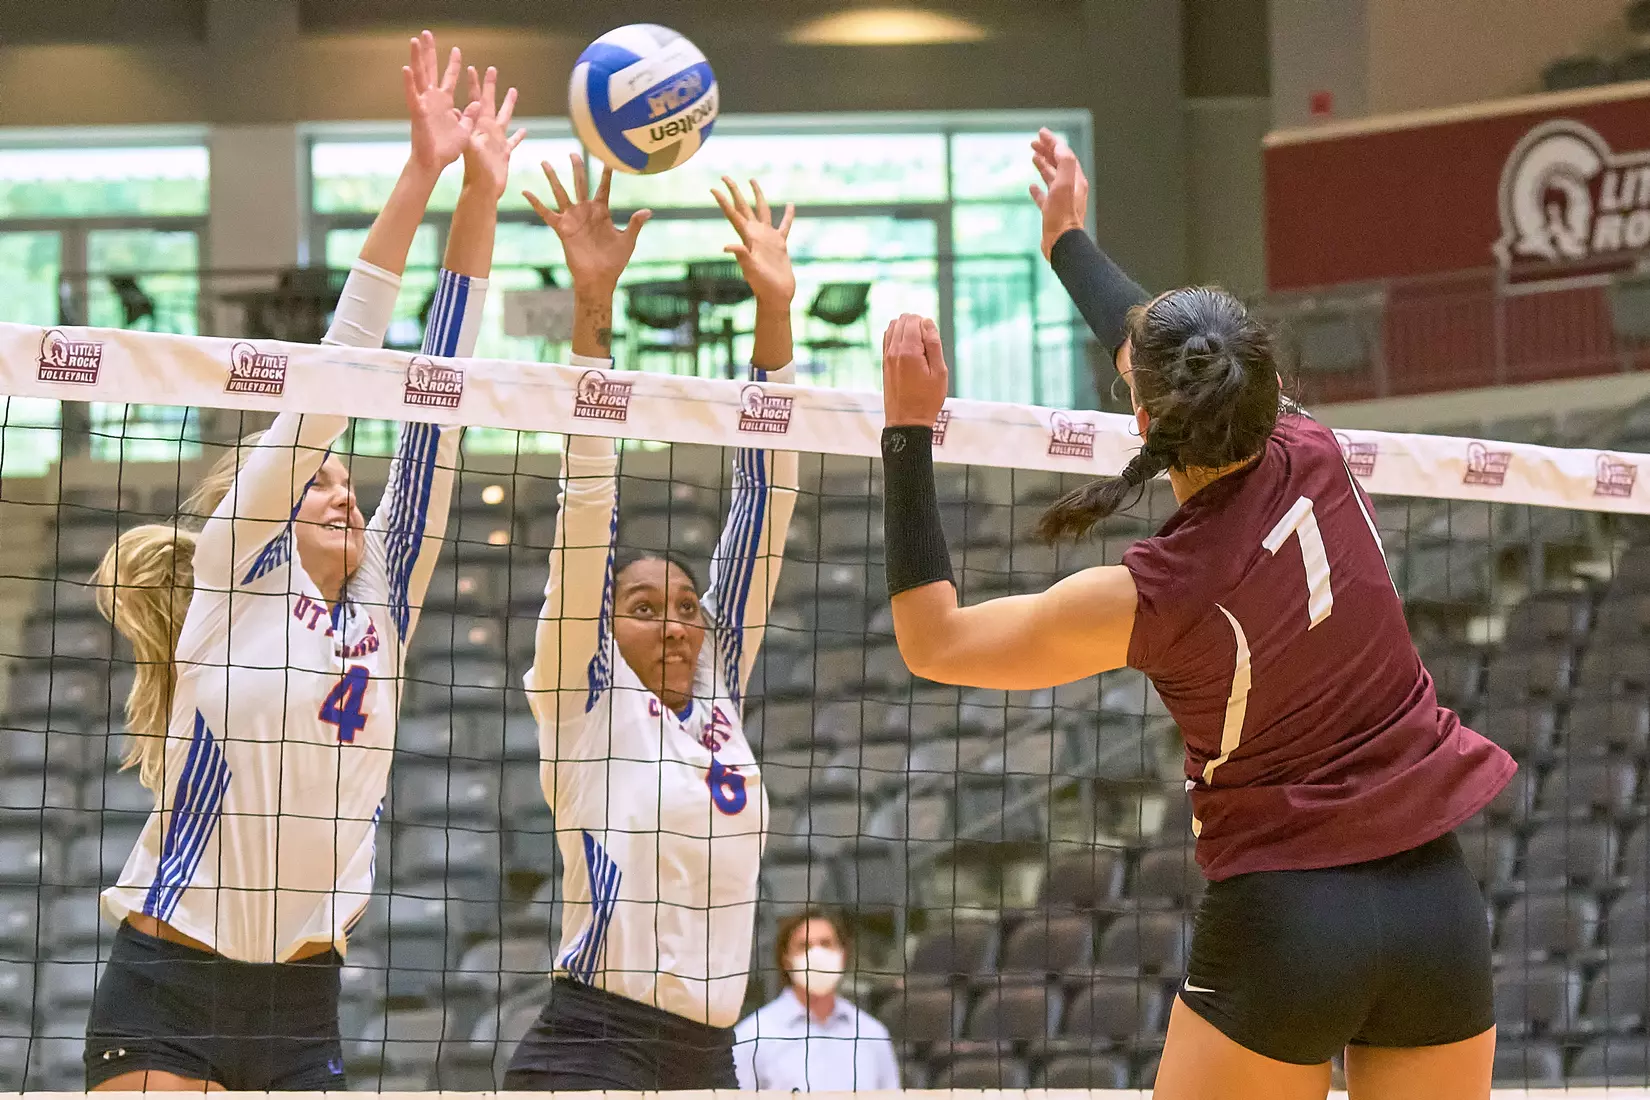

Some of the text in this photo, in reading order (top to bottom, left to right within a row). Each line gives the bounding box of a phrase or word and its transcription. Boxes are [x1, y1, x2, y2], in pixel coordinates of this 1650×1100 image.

[69, 344, 101, 357] LITTLE
[68, 356, 99, 368] ROCK
[255, 355, 287, 369] LITTLE
[41, 369, 94, 382] VOLLEYBALL
[251, 367, 284, 380] ROCK
[229, 381, 280, 393] VOLLEYBALL
[428, 381, 462, 393] ROCK
[406, 394, 458, 407] VOLLEYBALL
[598, 394, 628, 406] ROCK
[763, 396, 792, 409] LITTLE
[575, 407, 626, 420] VOLLEYBALL
[762, 408, 790, 420] ROCK
[740, 421, 785, 432] VOLLEYBALL
[1262, 496, 1333, 631] 7
[318, 664, 369, 744] 4
[705, 757, 747, 816] 6
